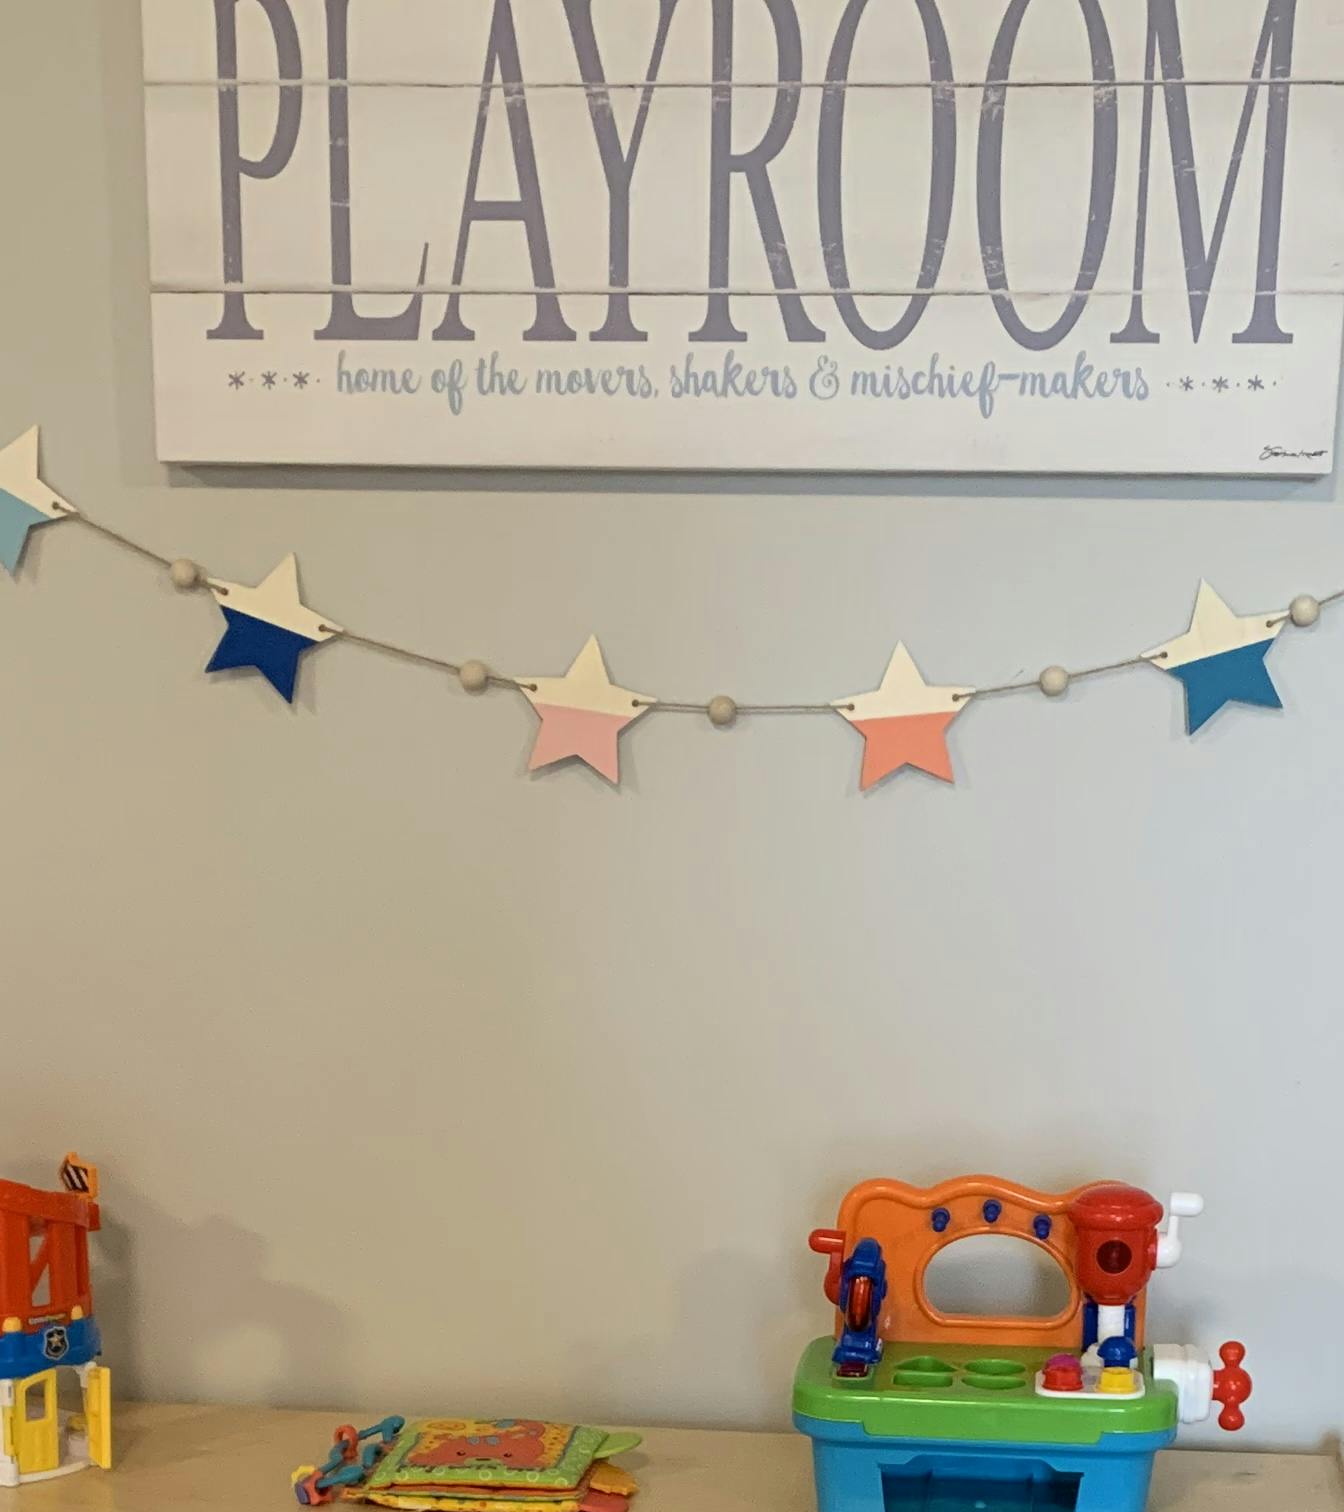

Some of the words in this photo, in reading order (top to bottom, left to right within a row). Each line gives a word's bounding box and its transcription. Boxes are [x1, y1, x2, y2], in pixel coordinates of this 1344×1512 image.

[206, 0, 1294, 351] PLAYROOM
[336, 350, 422, 396] home
[430, 358, 467, 416] of
[474, 350, 528, 396] the
[535, 364, 660, 398] movers,
[669, 350, 798, 399] shakers
[809, 355, 840, 400] &
[850, 350, 1150, 420] mischief-makers
